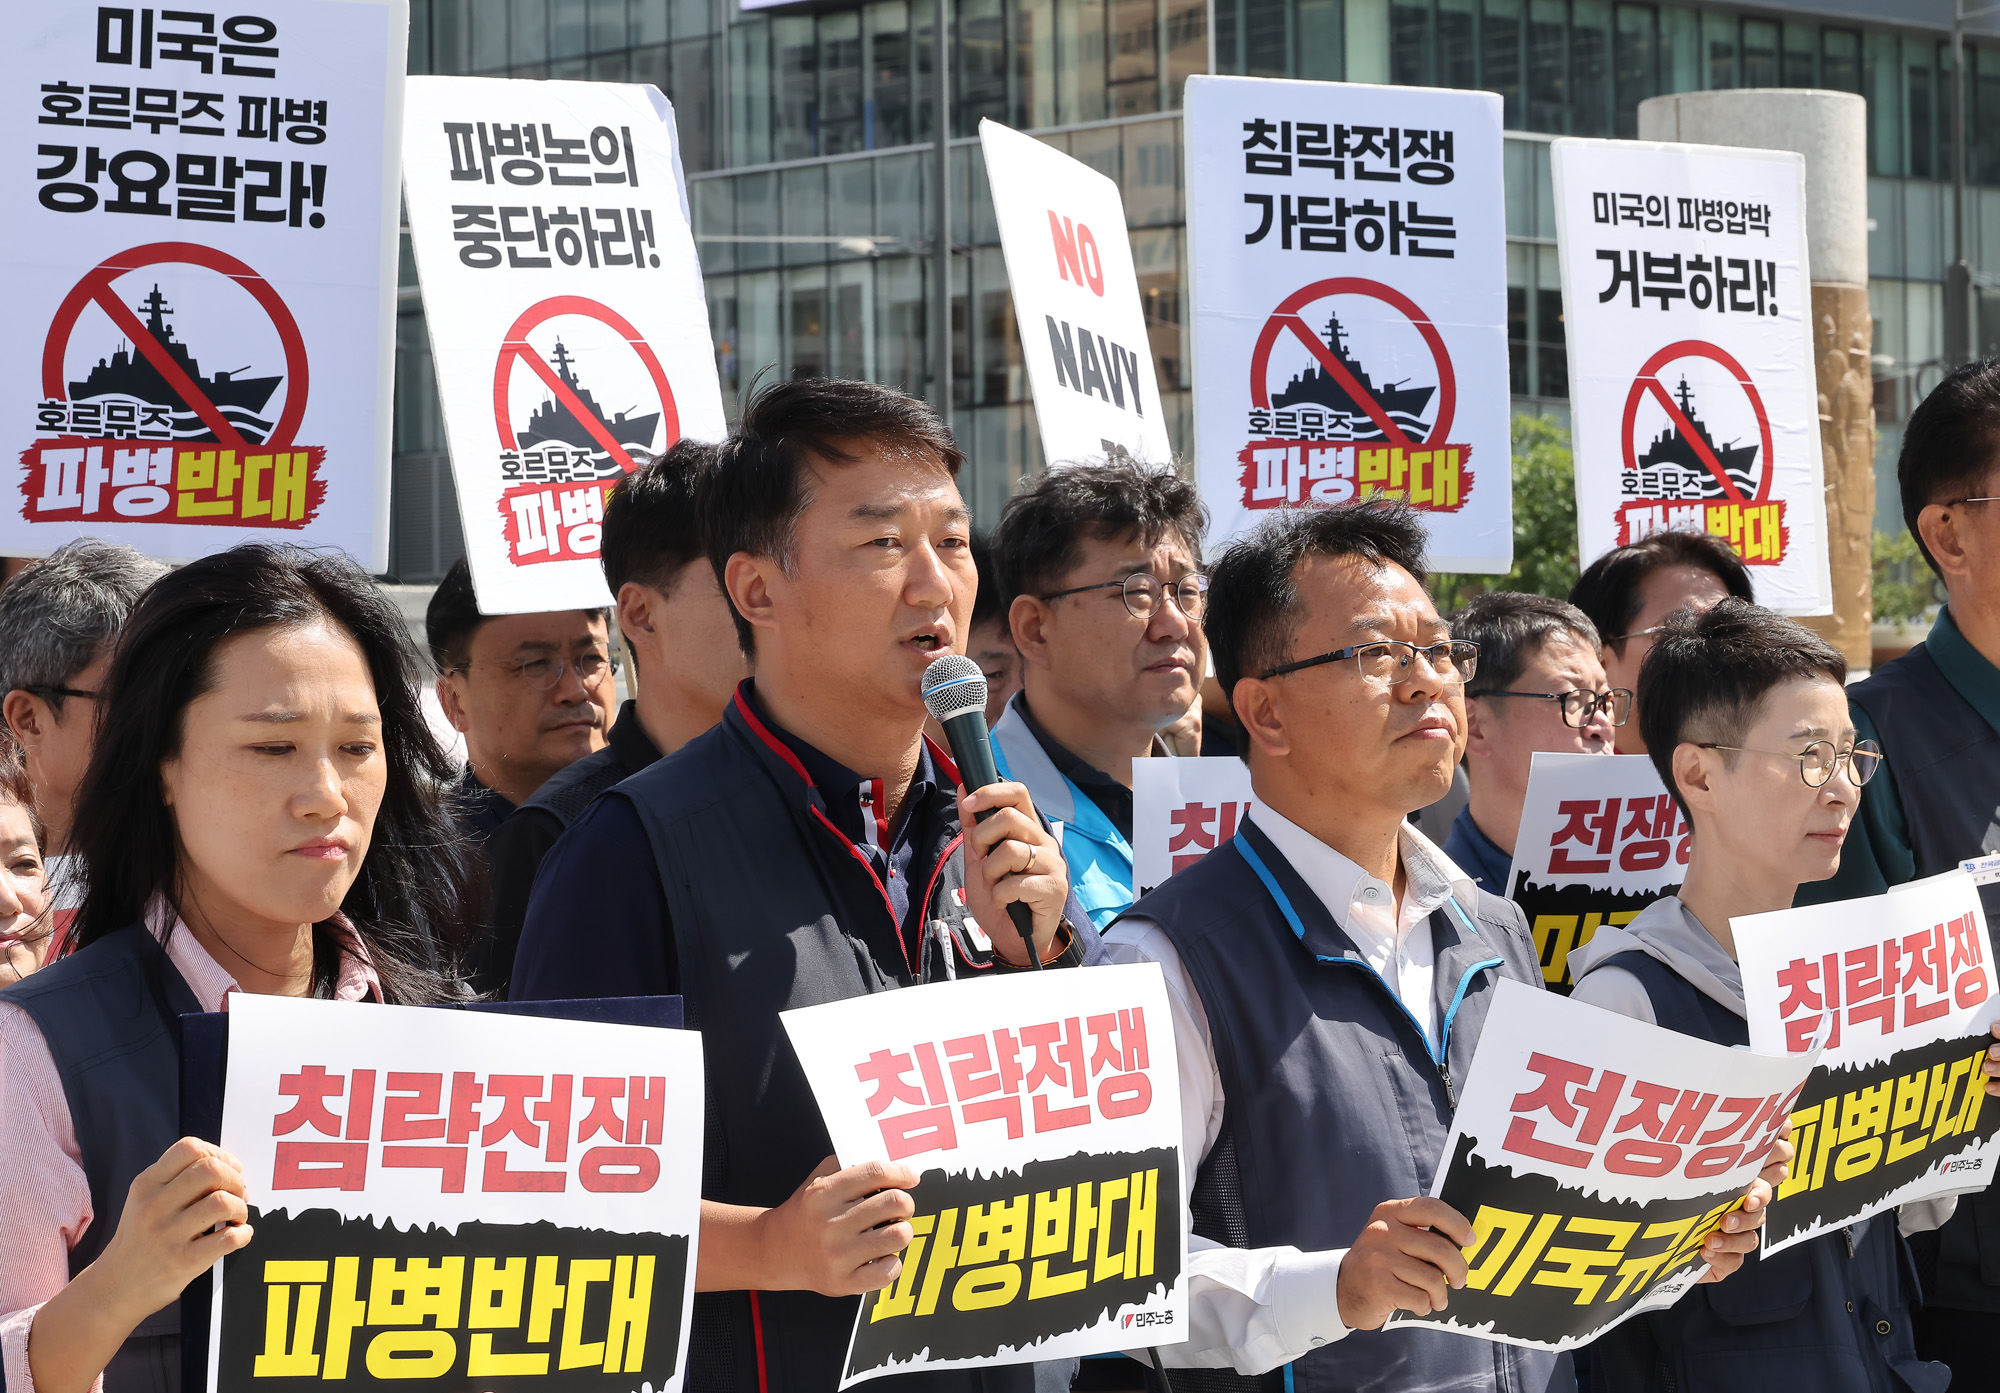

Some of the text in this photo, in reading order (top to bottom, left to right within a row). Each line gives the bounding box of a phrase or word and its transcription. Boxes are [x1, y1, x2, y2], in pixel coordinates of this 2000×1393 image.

[96, 7, 279, 78] 미국은
[38, 80, 328, 145] 호르무즈 파병
[443, 121, 639, 188] 파병논의
[1242, 118, 1455, 184] 침략전쟁
[36, 143, 327, 229] 강요말라!
[1592, 191, 1771, 238] 미국의 파병압박
[451, 204, 661, 269] 중단하라!
[1047, 209, 1104, 298] NO
[1244, 193, 1457, 259] 가담하는
[1595, 249, 1779, 317] 거부하라!
[1045, 314, 1144, 419] NAVY
[35, 402, 172, 439] 호르무즈
[1248, 410, 1353, 440] 호르무즈
[36, 446, 310, 523] 파병반대
[499, 451, 596, 481] 호르무즈
[1251, 446, 1460, 507] 파병반대
[1621, 471, 1701, 497] 호르무즈
[509, 486, 615, 557] 파병
[1776, 911, 1988, 1052] 침략전쟁
[854, 1007, 1153, 1162] 침략전쟁
[271, 1065, 666, 1194] 침략전쟁
[1777, 1049, 1991, 1202] 파병반대
[1950, 1158, 1984, 1173] 민주노총
[869, 1168, 1159, 1325] 파병반대
[253, 1255, 657, 1380] 파병반대
[1135, 1309, 1175, 1328] 민주노총
